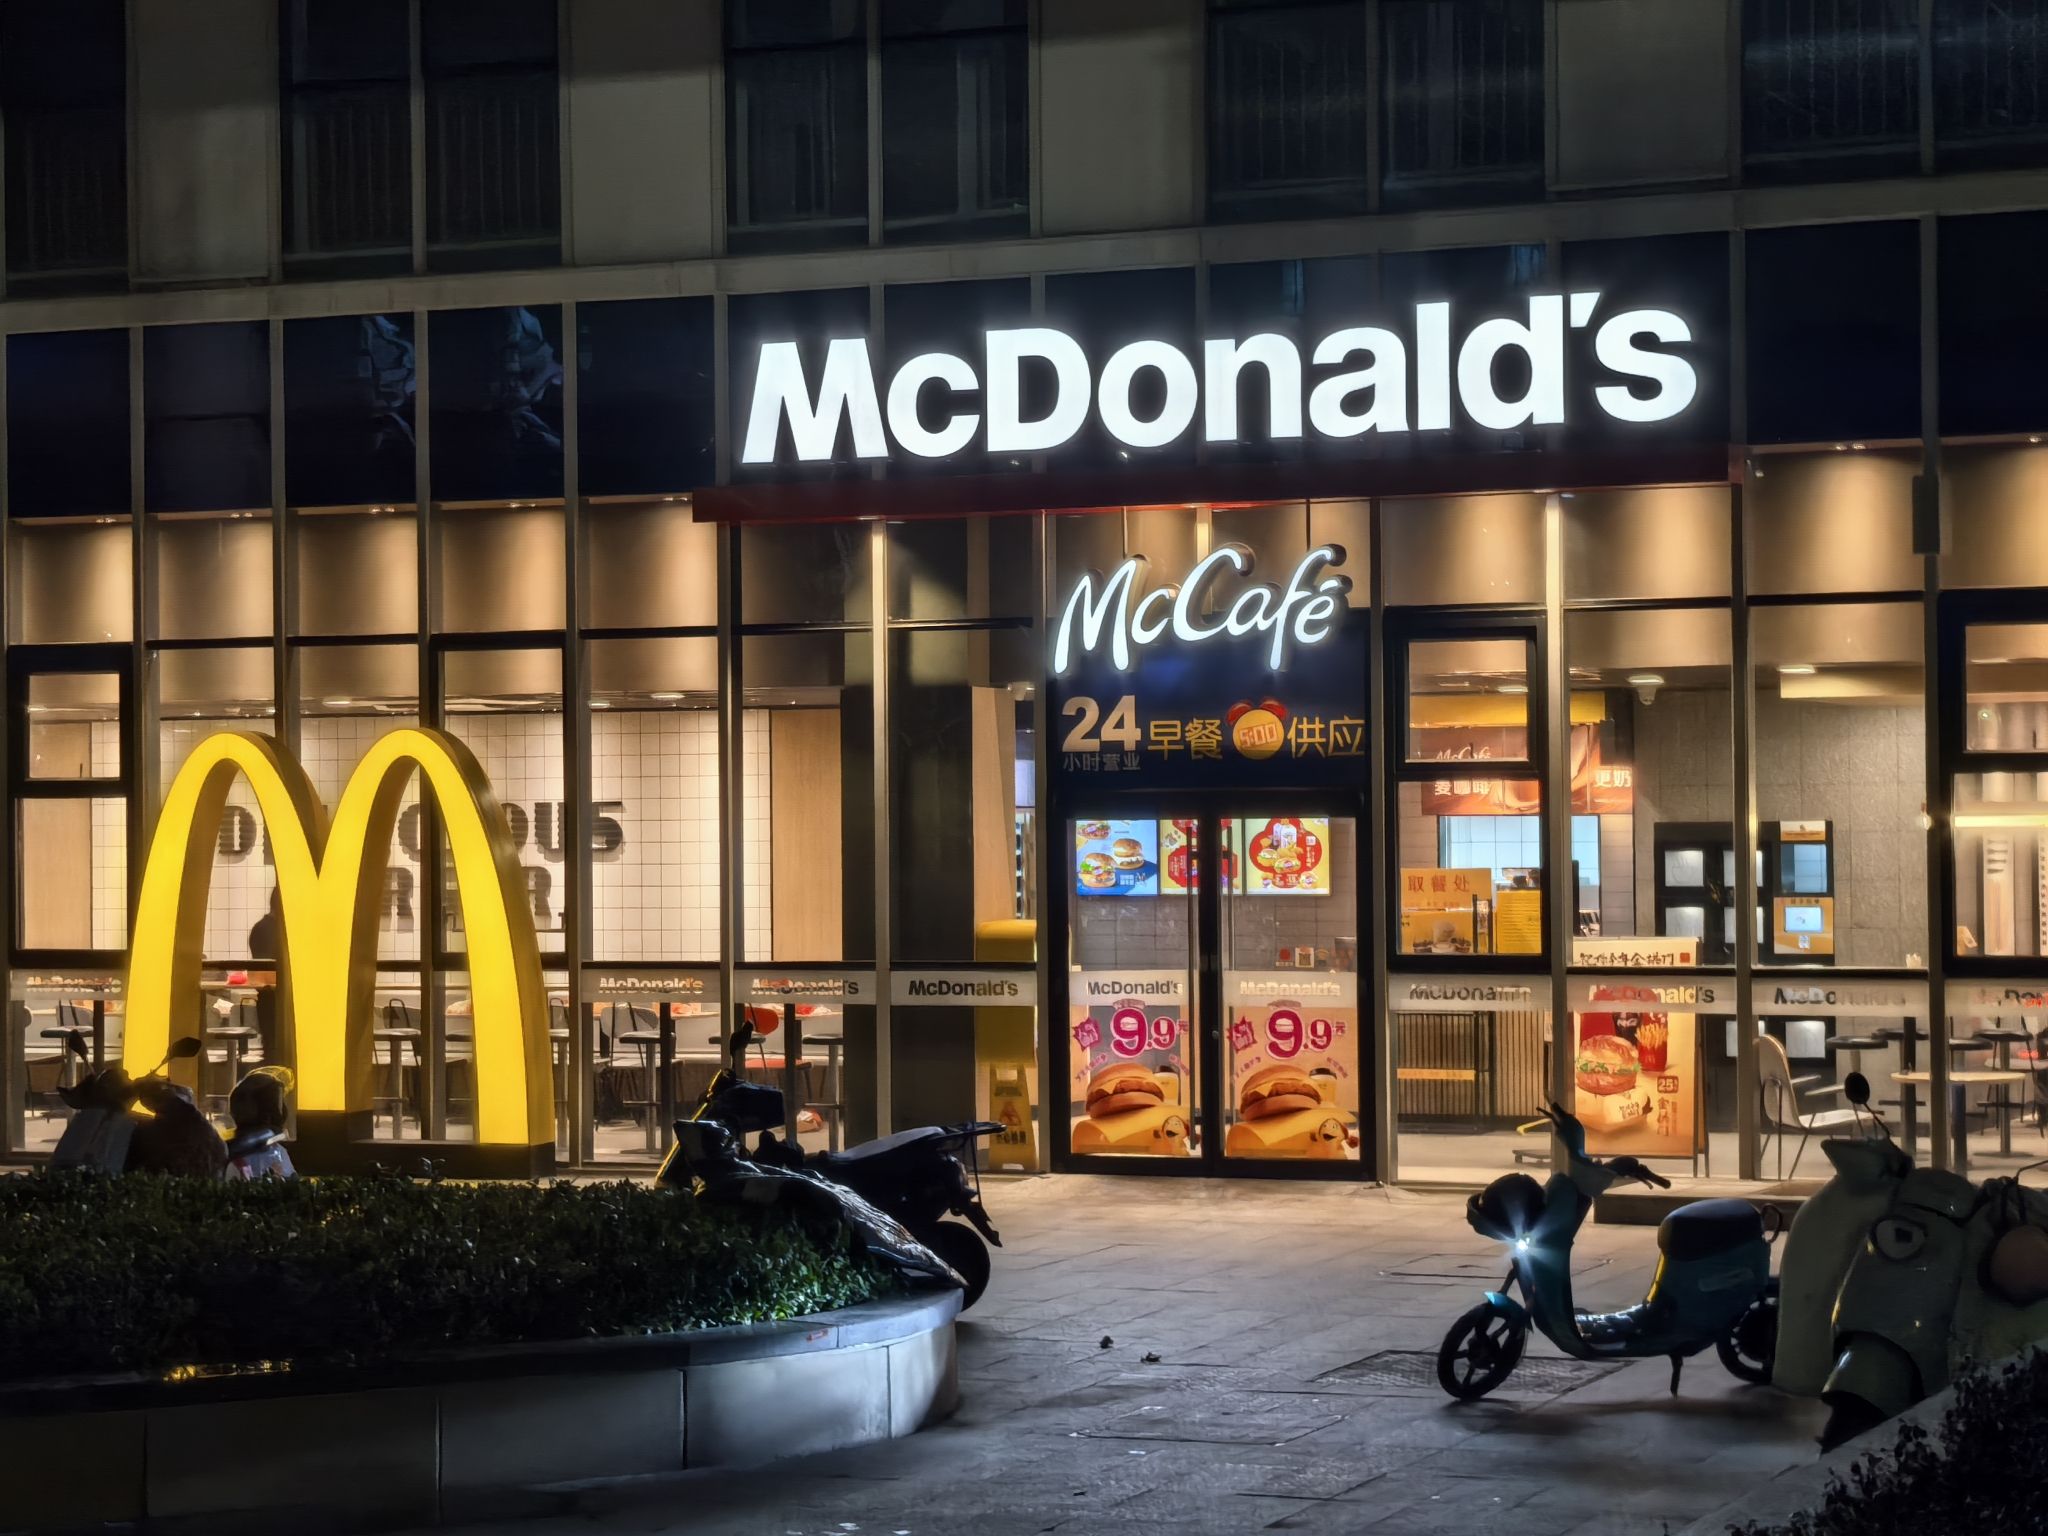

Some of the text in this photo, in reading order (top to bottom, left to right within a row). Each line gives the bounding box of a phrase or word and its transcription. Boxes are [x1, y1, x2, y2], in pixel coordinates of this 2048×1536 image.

[742, 292, 1697, 464] McDonald's
[1054, 548, 1340, 674] McCafé
[1062, 695, 1142, 752] 24
[1148, 718, 1223, 760] 早餐
[1287, 715, 1365, 759] 供应
[1063, 752, 1141, 772] 小时营业
[1407, 874, 1470, 893] 取餐处
[908, 979, 1018, 997] McDonald's
[1087, 979, 1184, 996] McDonald's
[1240, 981, 1340, 996] McDonald's
